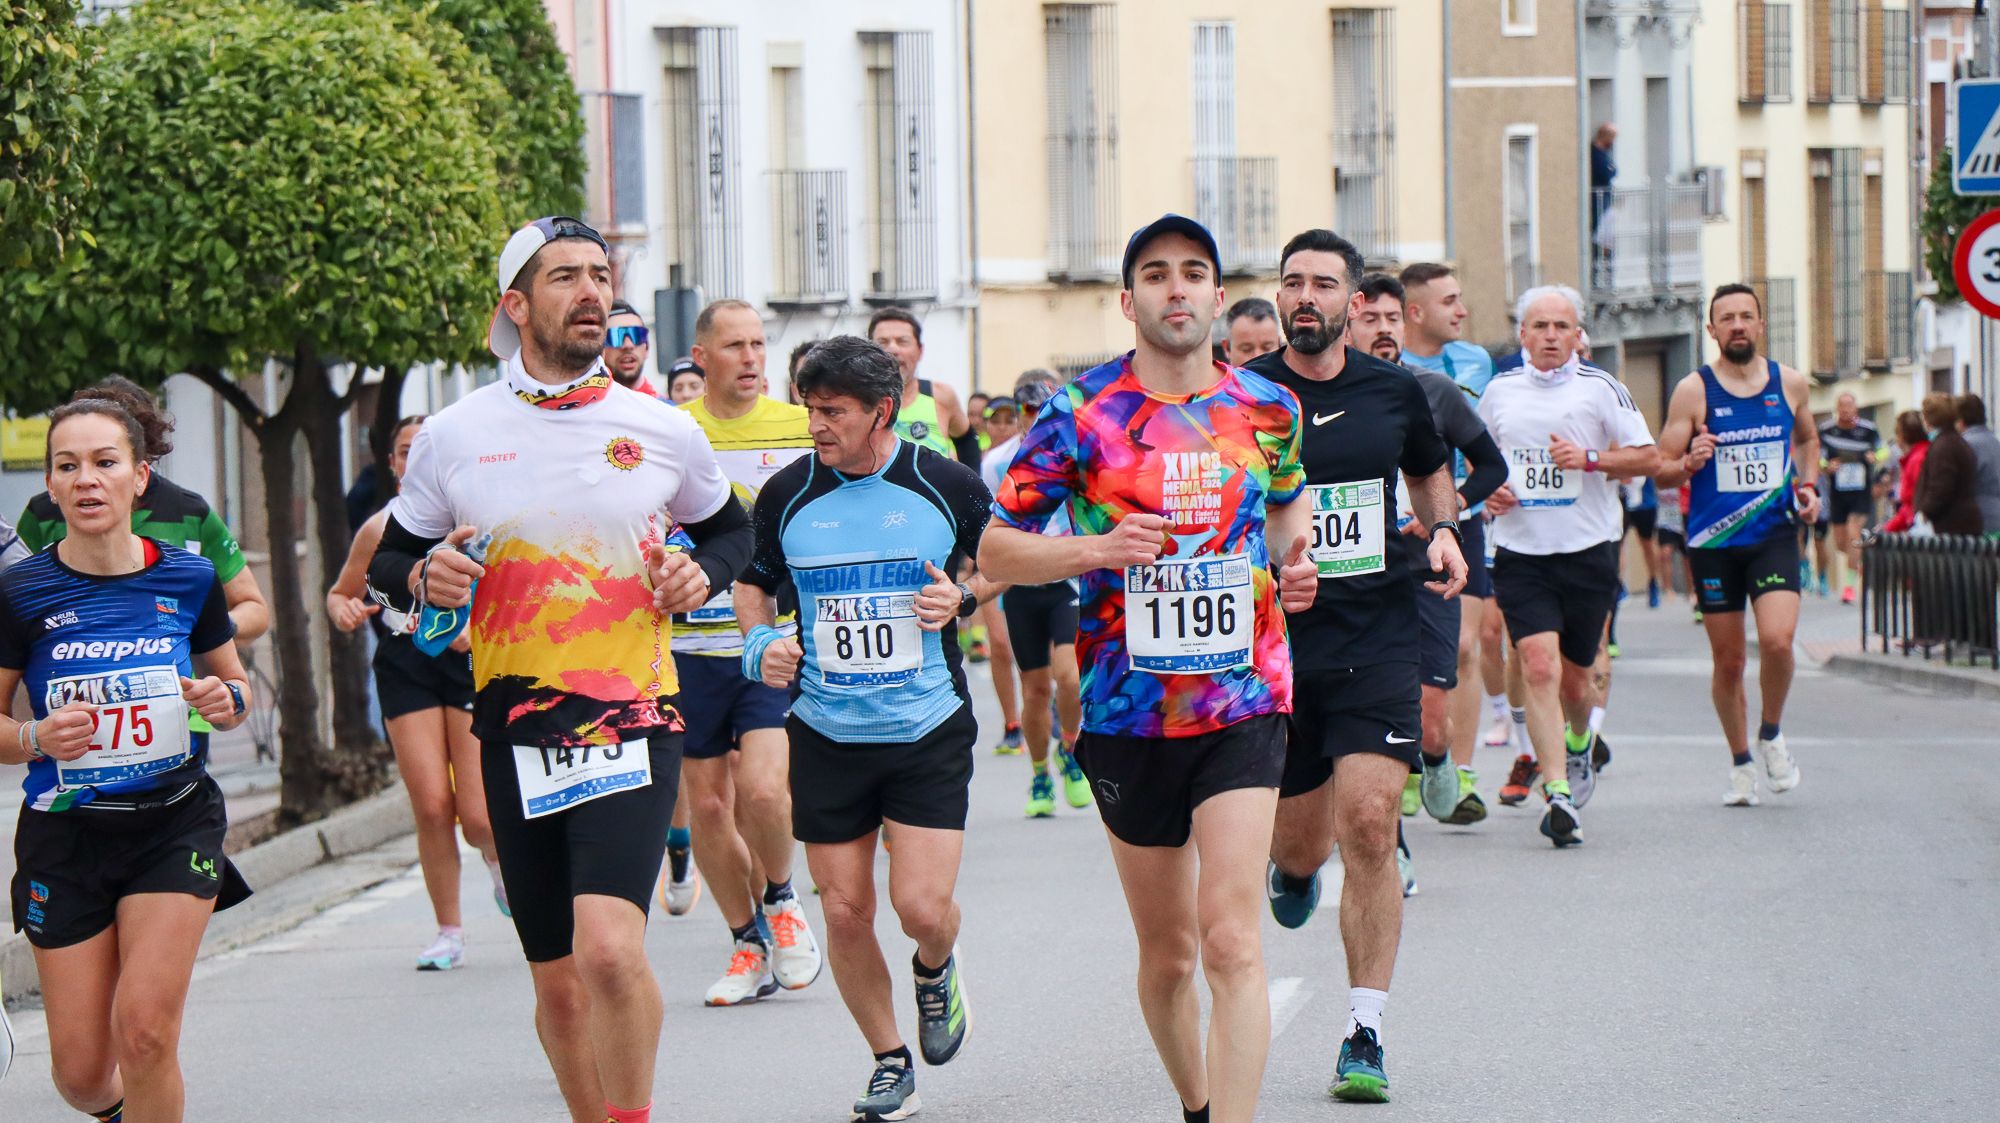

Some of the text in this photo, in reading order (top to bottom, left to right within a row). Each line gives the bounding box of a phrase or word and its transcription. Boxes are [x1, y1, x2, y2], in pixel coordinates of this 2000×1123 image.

[479, 452, 517, 464] FASTER
[1162, 452, 1200, 480] XII
[1200, 451, 1221, 470] 08
[1526, 467, 1563, 490] 846
[1733, 463, 1768, 486] 163
[1163, 480, 1201, 495] MEDIA
[1163, 491, 1222, 510] MARATÓN
[1171, 510, 1194, 525] 10K
[1195, 515, 1220, 525] LUCENA
[1311, 511, 1362, 549] 504
[885, 548, 918, 559] BAENA
[798, 566, 861, 593] MEDIA
[1143, 564, 1185, 592] 21K
[58, 610, 76, 619] RUN
[60, 616, 79, 626] PRO
[827, 598, 858, 621] 21K
[1145, 593, 1235, 638] 1196
[52, 637, 173, 661] enerplus
[835, 623, 893, 660] 810
[63, 679, 107, 706] 21K
